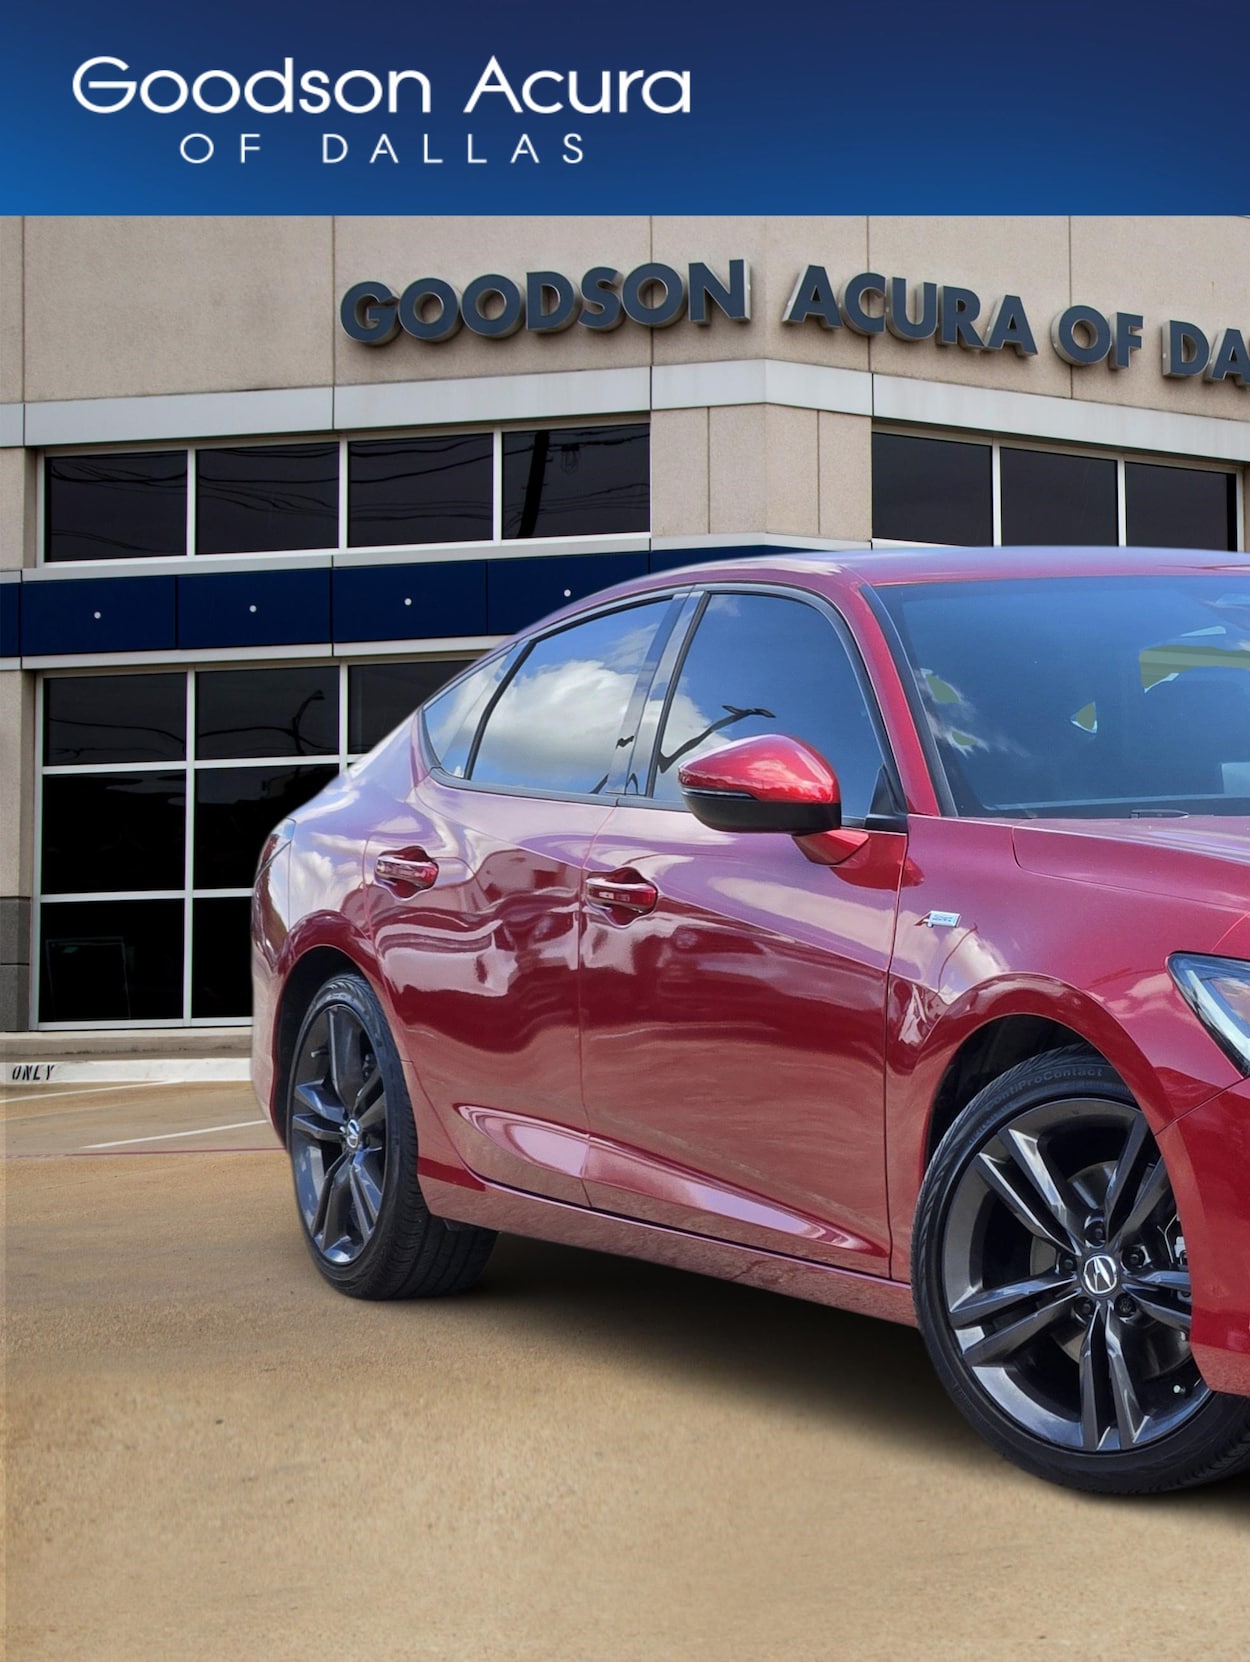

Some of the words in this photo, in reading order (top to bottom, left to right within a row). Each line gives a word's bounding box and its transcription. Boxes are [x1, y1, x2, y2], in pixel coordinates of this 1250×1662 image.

[340, 258, 750, 347] GOODSON
[783, 264, 1039, 356] ACURA
[1054, 304, 1145, 371] OF
[12, 1065, 55, 1080] ONLY
